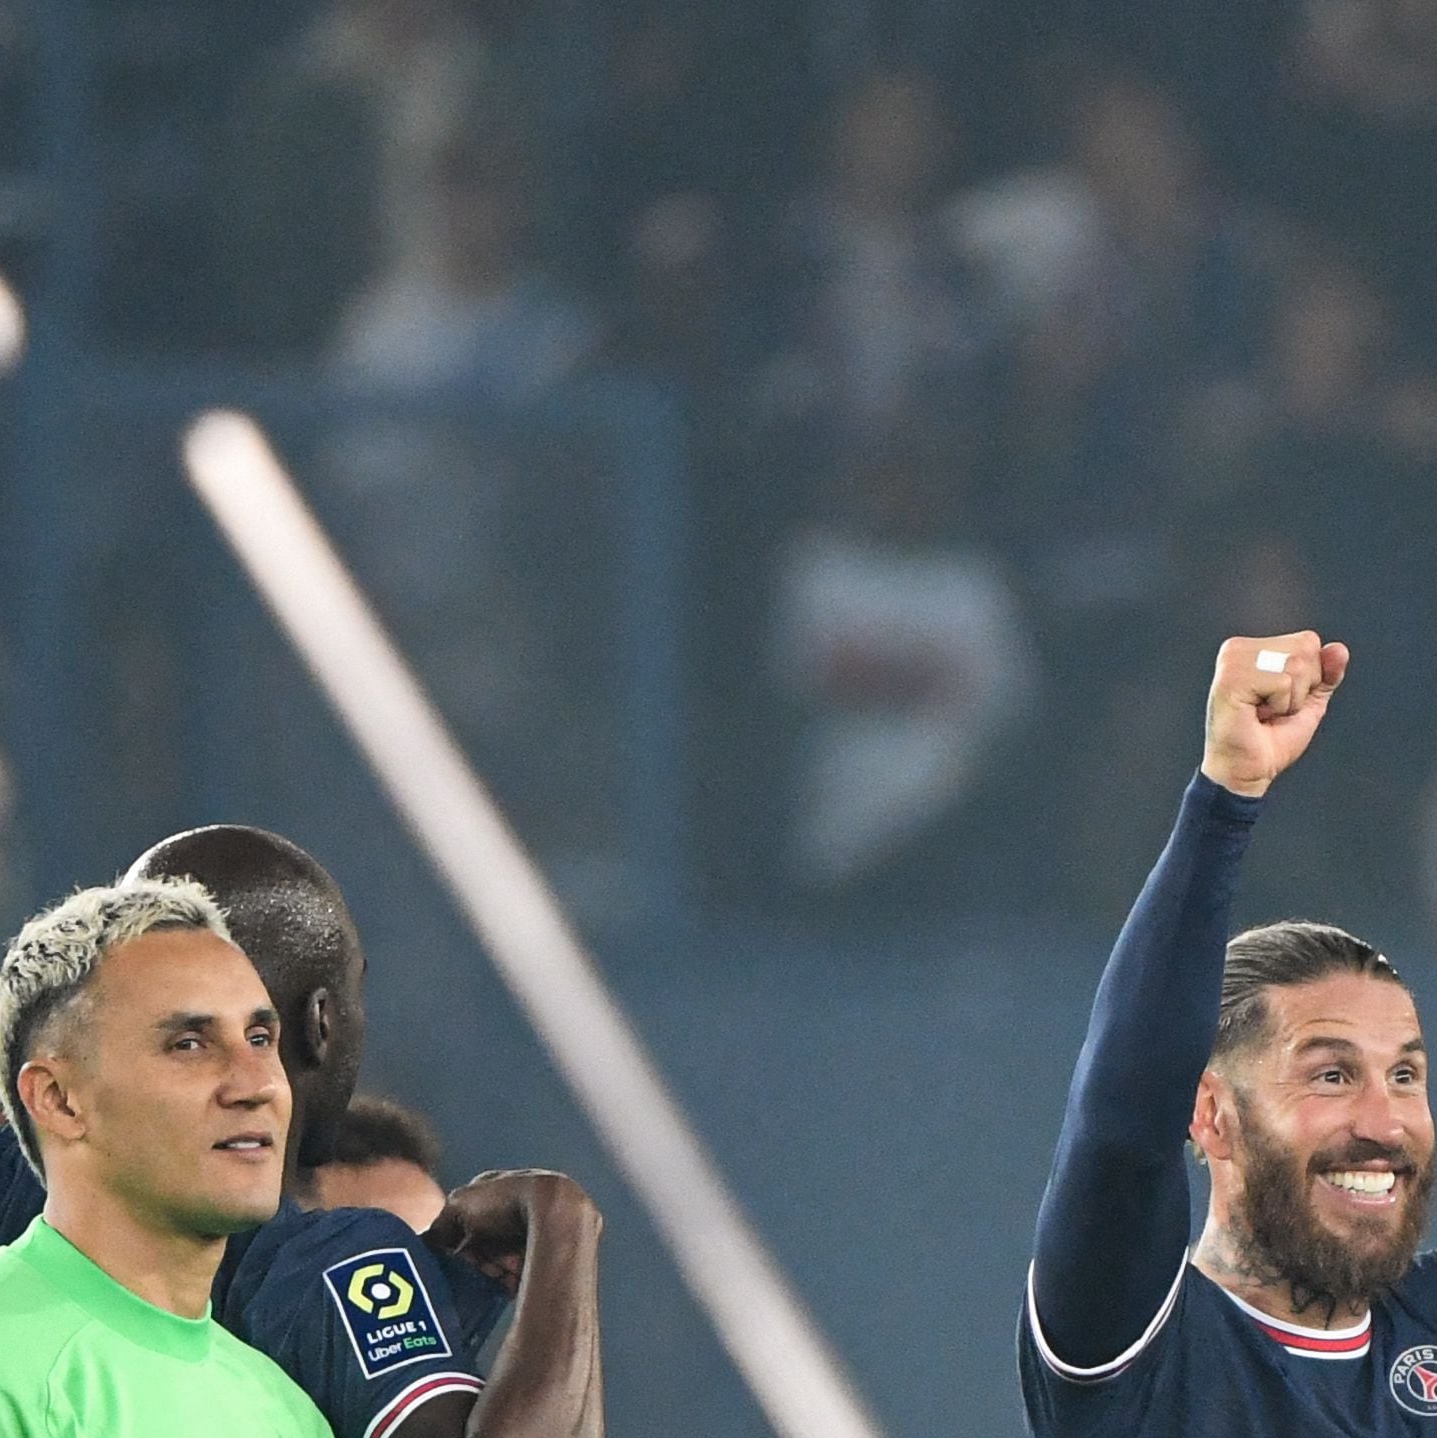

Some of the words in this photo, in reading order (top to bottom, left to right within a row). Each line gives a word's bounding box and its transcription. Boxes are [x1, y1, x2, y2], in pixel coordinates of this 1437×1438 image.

[366, 1321, 417, 1344] LIGUE
[418, 1320, 427, 1331] 1
[368, 1342, 402, 1361] Uber
[403, 1336, 437, 1349] Eats
[1394, 1349, 1435, 1384] PARIS
